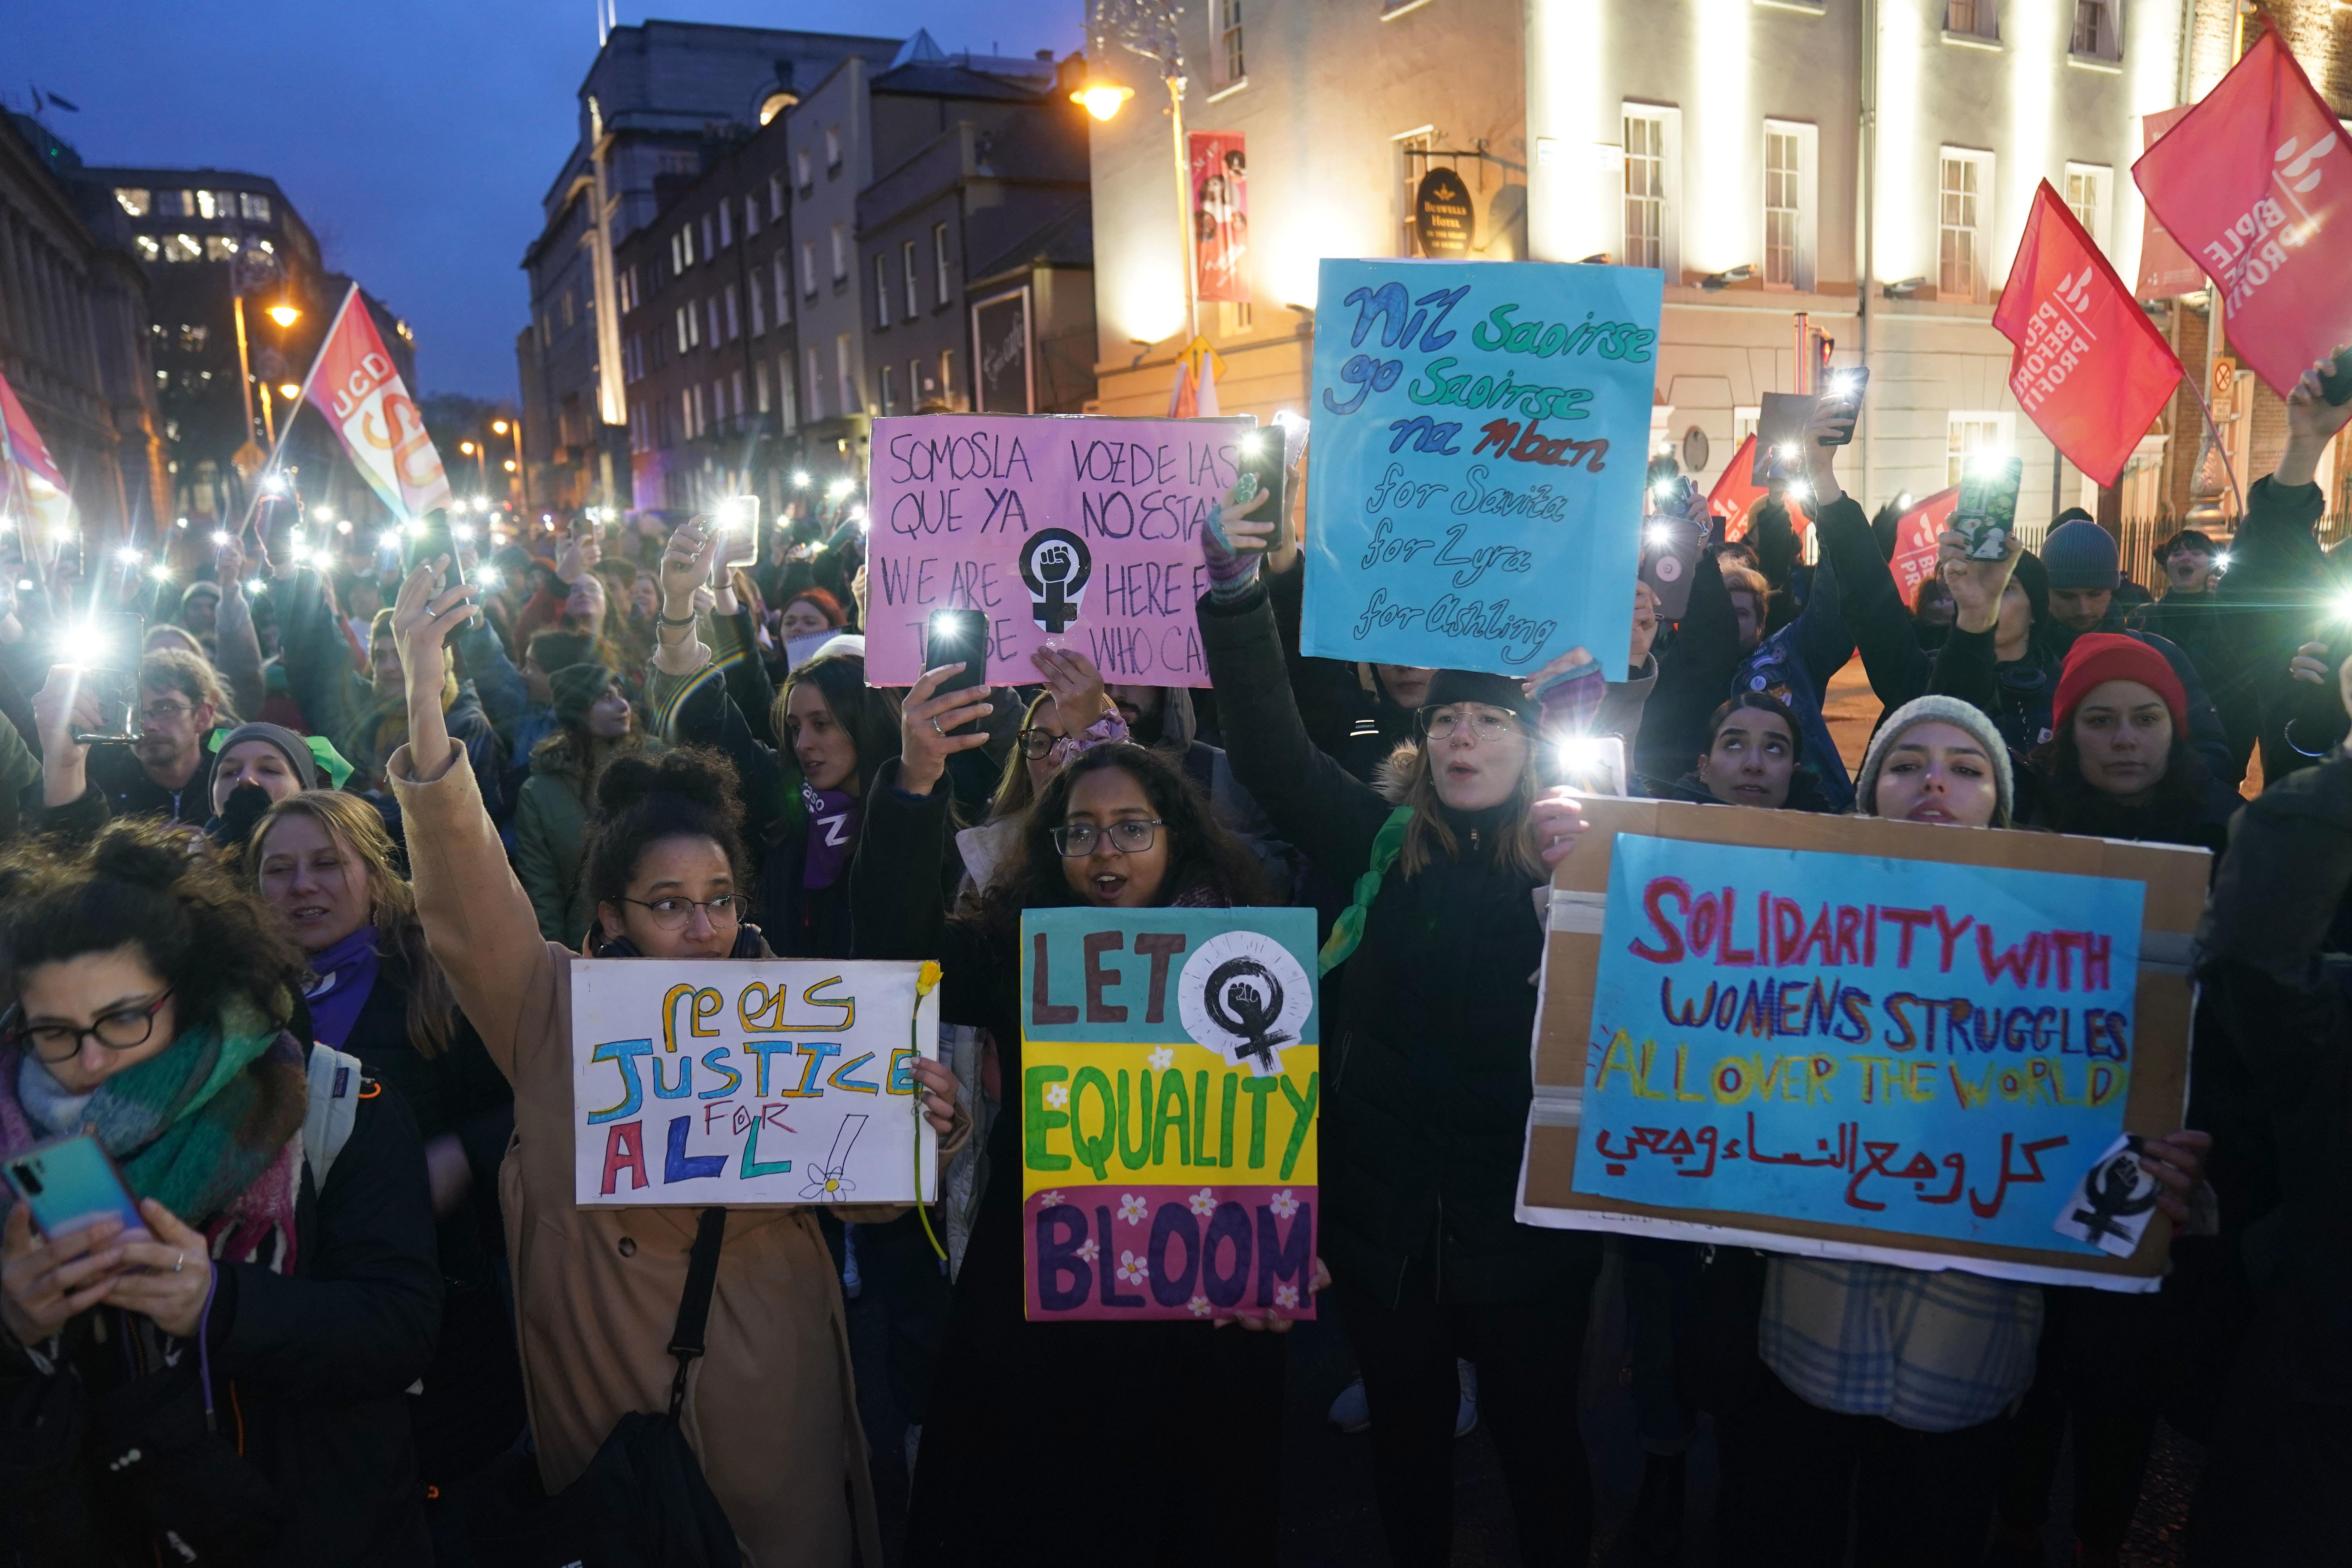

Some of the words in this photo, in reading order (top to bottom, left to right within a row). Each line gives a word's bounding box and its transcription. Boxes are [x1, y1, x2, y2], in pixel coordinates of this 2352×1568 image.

[1472, 304, 1655, 363] Saoirse
[332, 352, 390, 419] UCD
[1323, 355, 1403, 416] go
[1408, 358, 1593, 421] Saoirse
[1389, 416, 1462, 456] na
[891, 488, 963, 540] QUE
[980, 488, 1029, 534] YA
[1138, 489, 1217, 542] ESTA
[1366, 462, 1448, 514] for
[1451, 465, 1568, 522] Savita
[1361, 517, 1435, 570] for
[1434, 524, 1532, 588] Lyra
[880, 556, 938, 606] WE
[947, 561, 1002, 611] ARE
[1105, 562, 1183, 618] HERE
[1354, 588, 1425, 640] for
[1089, 626, 1152, 676] WHO
[1161, 626, 1209, 678] CA
[1628, 875, 1975, 973] SOLIDARITY
[1975, 924, 2112, 993] WITH
[1031, 930, 1186, 1025] LET
[1660, 975, 1873, 1045] WOMENS
[1883, 991, 2129, 1062] STRUGGLES
[587, 1038, 924, 1125] JUSTICE
[1595, 1026, 1707, 1101] ALL
[1710, 1051, 1840, 1107] OVER
[1846, 1054, 1938, 1105] THE
[1948, 1054, 2129, 1110] WORLD
[704, 1100, 798, 1135] FOR
[1024, 1064, 1319, 1181] EQUALITY
[1969, 1132, 2069, 1218] كل
[1036, 1201, 1313, 1311] BLOOM
